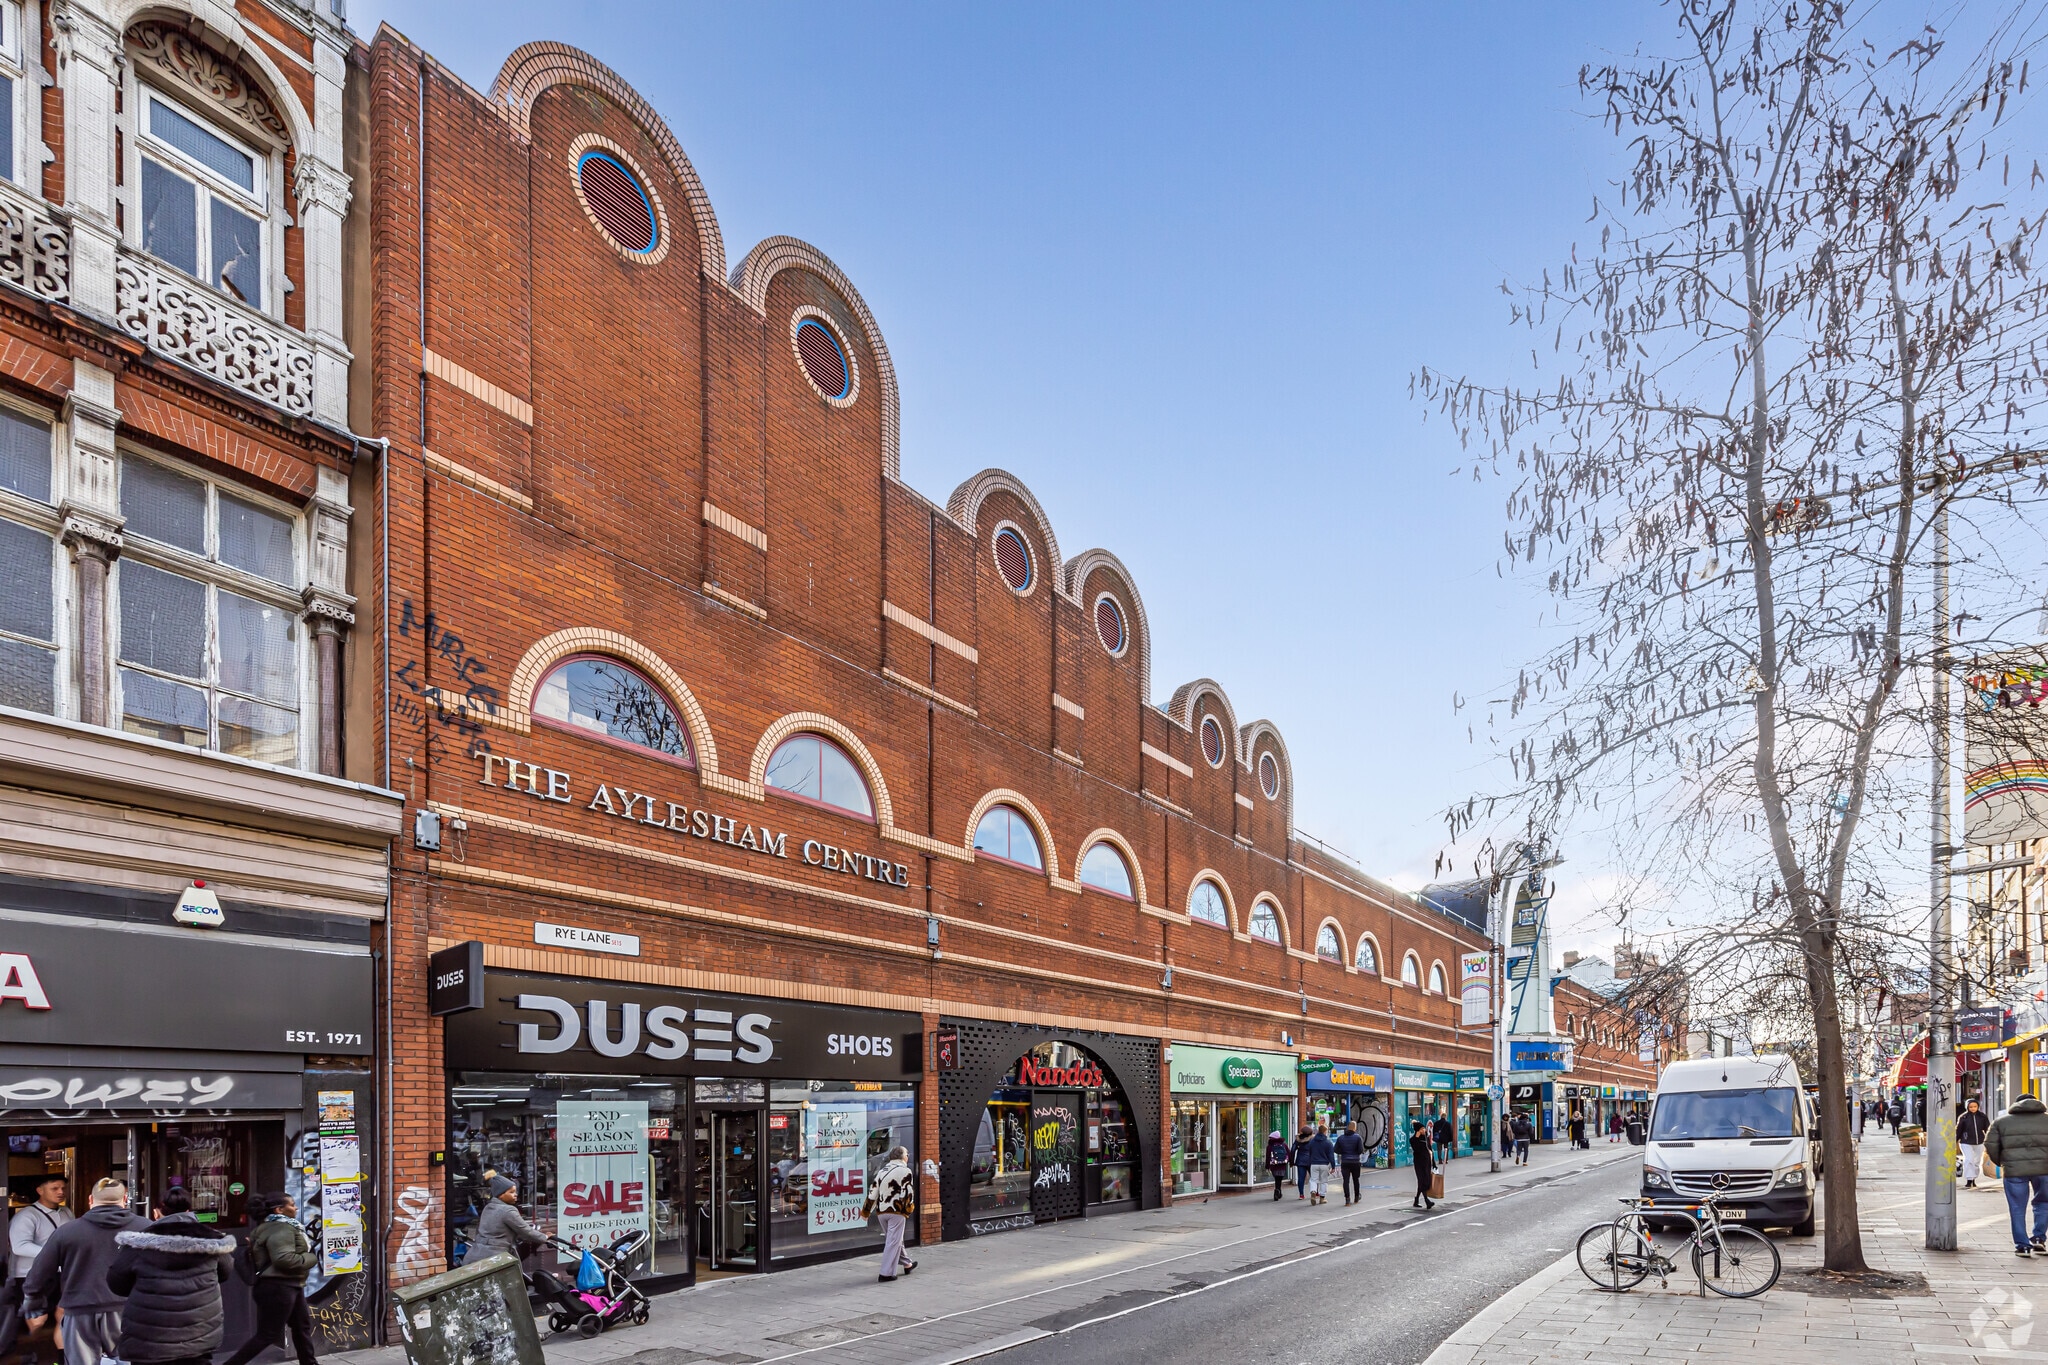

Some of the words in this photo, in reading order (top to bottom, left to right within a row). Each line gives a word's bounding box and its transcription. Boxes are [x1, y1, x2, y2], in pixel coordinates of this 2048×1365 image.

[473, 748, 573, 804] THE
[588, 784, 788, 859] AYLESHAM
[803, 839, 910, 888] CENTRE
[182, 903, 219, 916] SECOM
[555, 927, 576, 940] RYE
[581, 931, 611, 945] LANE
[1463, 956, 1487, 966] THANK
[1466, 963, 1487, 974] YOU
[437, 968, 464, 991] DUSES
[518, 993, 775, 1065] DUSES
[286, 1030, 320, 1044] EST.
[326, 1032, 363, 1046] 1971
[826, 1033, 893, 1057] SHOES
[1019, 1056, 1103, 1087] Nando's
[1228, 1064, 1261, 1079] Specsavers
[1301, 1062, 1330, 1070] Specsavers
[1178, 1071, 1206, 1086] Opticians
[1271, 1077, 1293, 1090] Opticians
[1398, 1073, 1424, 1086] Poundland
[1515, 1086, 1534, 1099] JD
[588, 1110, 621, 1121] END
[827, 1111, 849, 1120] END
[593, 1121, 615, 1131] OF
[818, 1128, 857, 1137] SEASON
[573, 1131, 634, 1142] SEASON
[569, 1143, 638, 1154] CLEARANCE
[811, 1168, 864, 1197] SALE
[563, 1180, 643, 1217] SALE
[814, 1200, 839, 1208] SHOES
[840, 1198, 862, 1206] FROM
[815, 1206, 862, 1226] £9.99
[568, 1221, 606, 1231] SHOES
[608, 1217, 640, 1227] FROM
